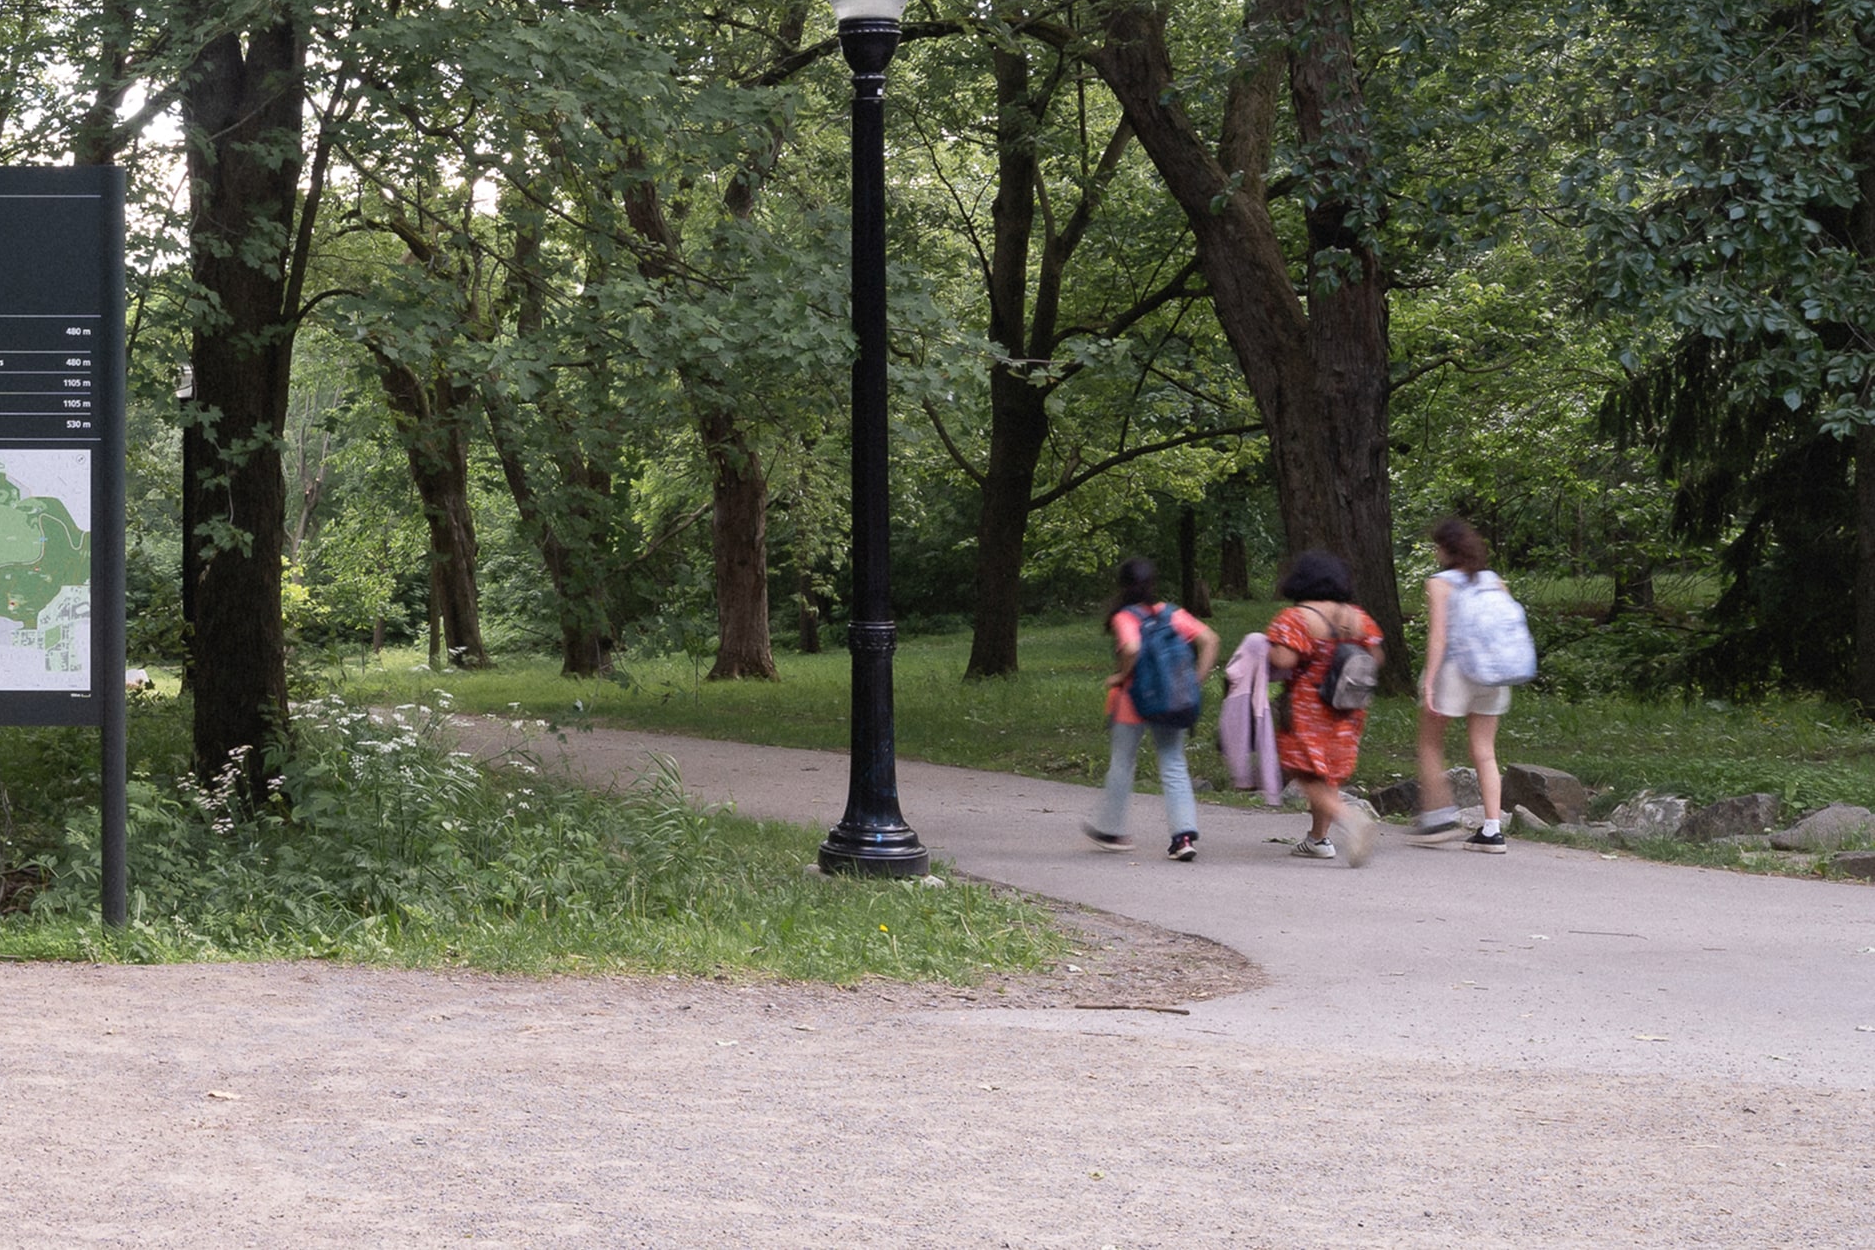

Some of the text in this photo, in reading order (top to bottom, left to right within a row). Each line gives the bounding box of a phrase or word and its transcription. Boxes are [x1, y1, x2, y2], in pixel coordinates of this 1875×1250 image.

[66, 327, 82, 336] 480
[66, 358, 82, 367] 480
[63, 379, 82, 387] 1105
[63, 399, 82, 408] 1105
[66, 420, 82, 428] 530
